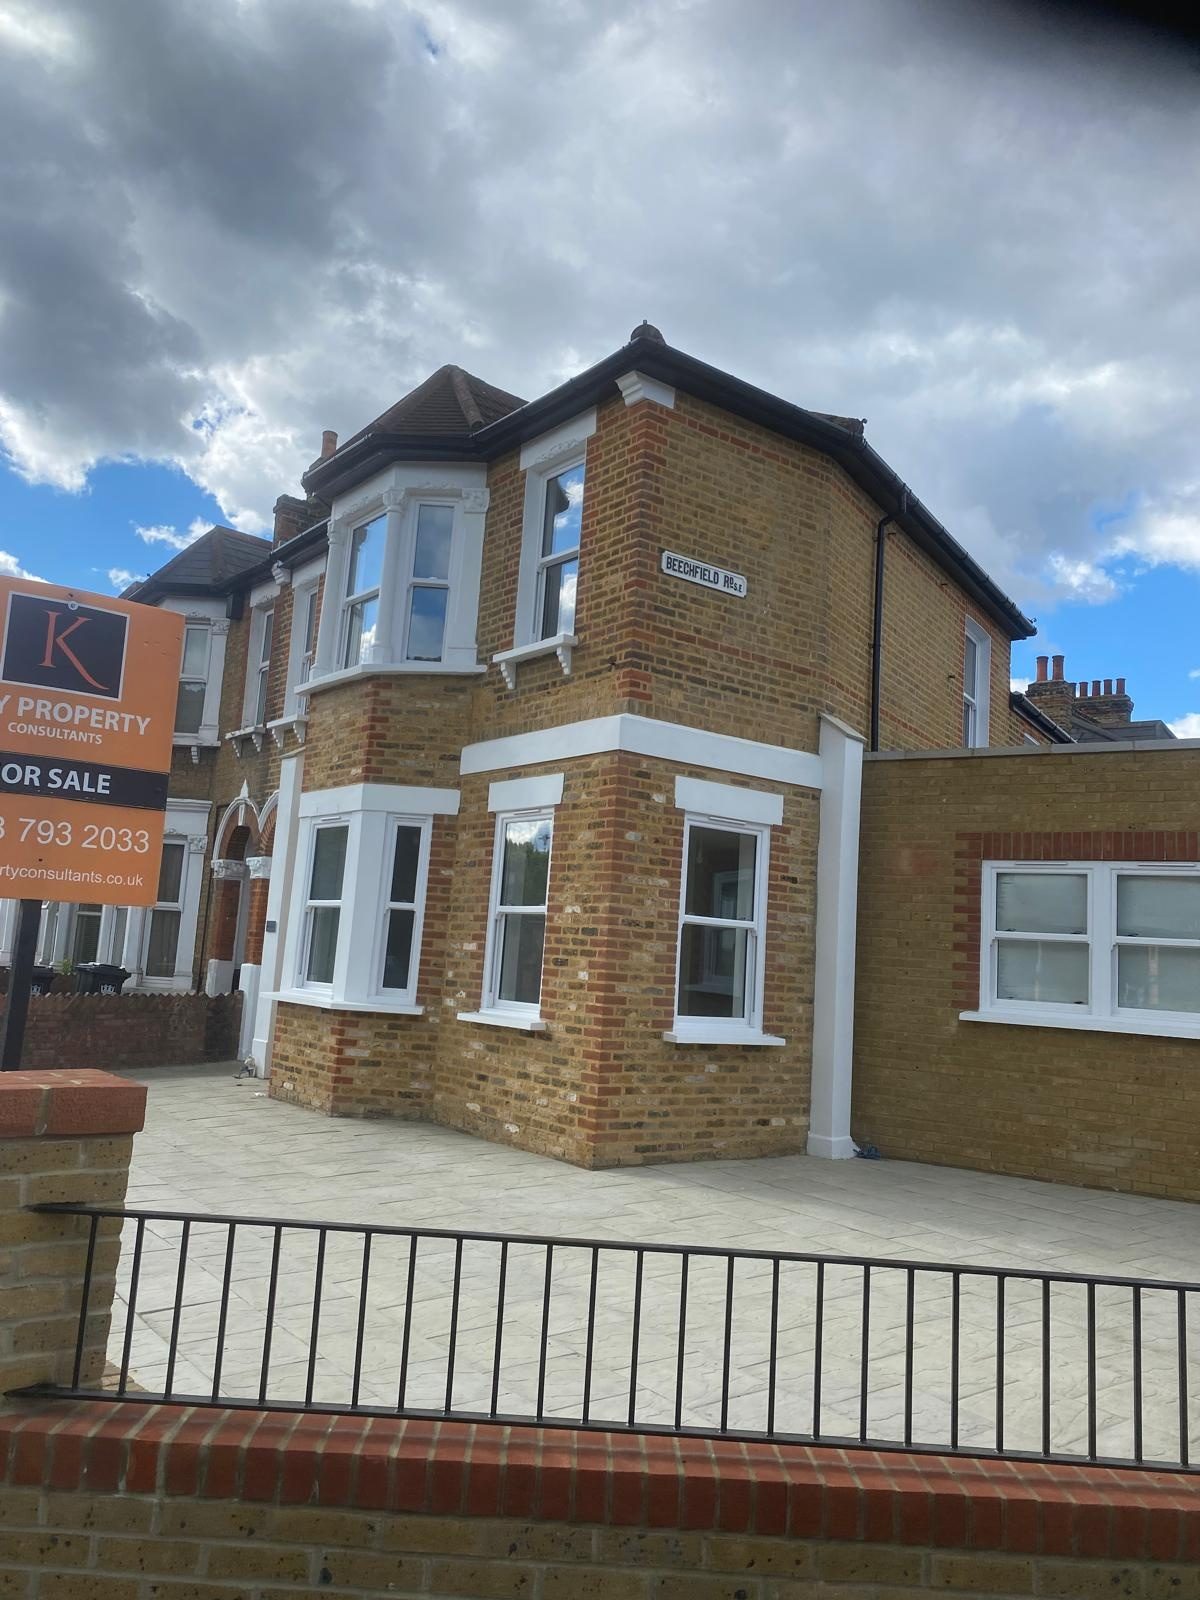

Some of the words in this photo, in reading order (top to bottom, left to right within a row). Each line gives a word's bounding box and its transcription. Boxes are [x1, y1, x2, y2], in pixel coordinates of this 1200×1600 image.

[666, 556, 719, 585] BEECHFIELD
[38, 610, 110, 690] K
[17, 696, 151, 736] PROPERTY
[8, 722, 103, 745] CONSULTANTS
[1, 763, 41, 787] OR
[47, 768, 111, 795] SALE
[18, 817, 73, 846] 793
[81, 824, 150, 854] 2033
[0, 863, 144, 887] rtyconsultants.co.uk
